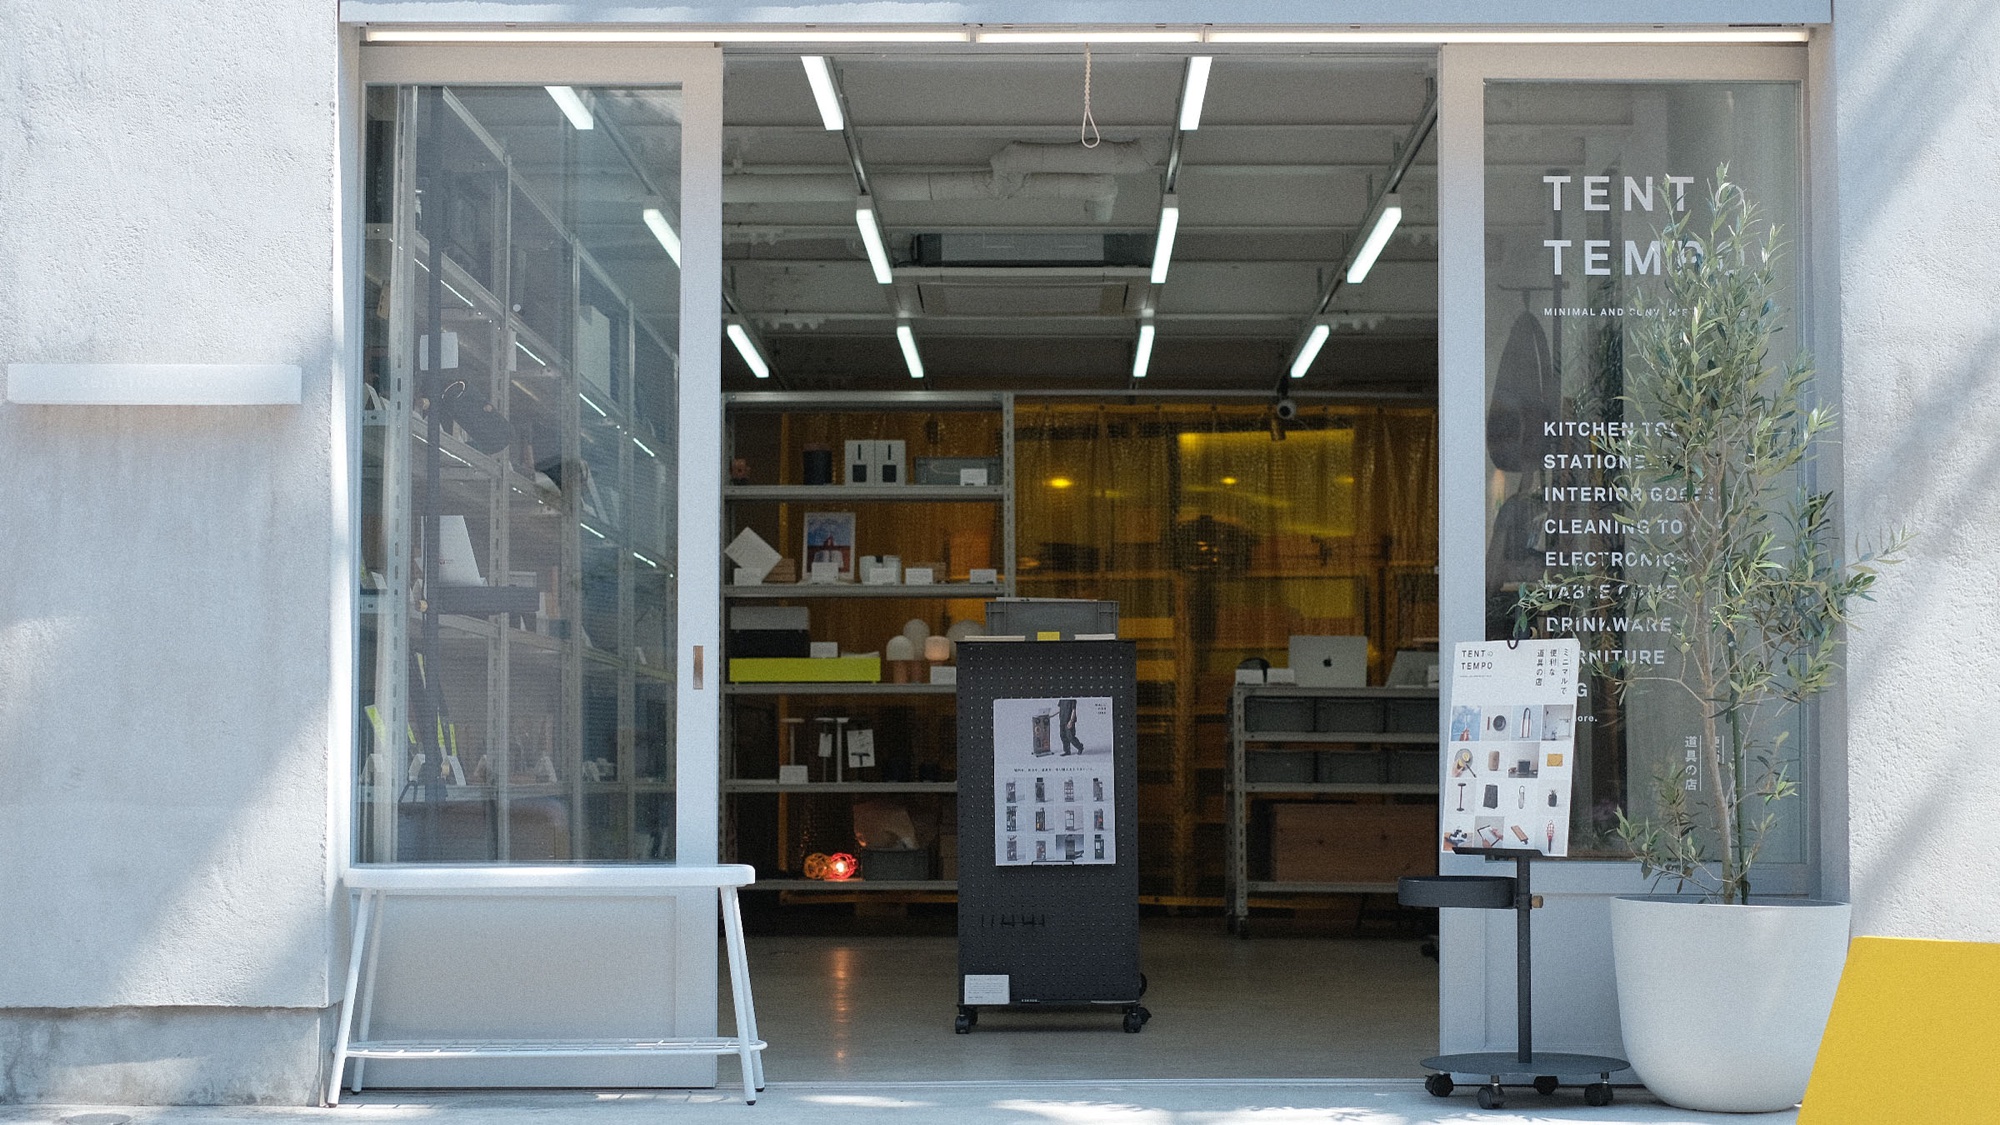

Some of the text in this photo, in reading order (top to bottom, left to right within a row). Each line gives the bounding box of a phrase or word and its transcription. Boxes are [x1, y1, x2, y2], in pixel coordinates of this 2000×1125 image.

[1543, 176, 1694, 211] TENT
[1544, 307, 1596, 317] MINIMAL
[1600, 307, 1624, 317] AND
[1544, 421, 1634, 437] KITCHEN
[1545, 486, 1642, 502] INTERIOR
[1544, 519, 1650, 534] CLEANING
[1545, 551, 1687, 567] ELECTRONIC
[1461, 649, 1486, 658] TENT
[1461, 661, 1493, 670] TEMPO
[1684, 735, 1698, 791] 道具の店
